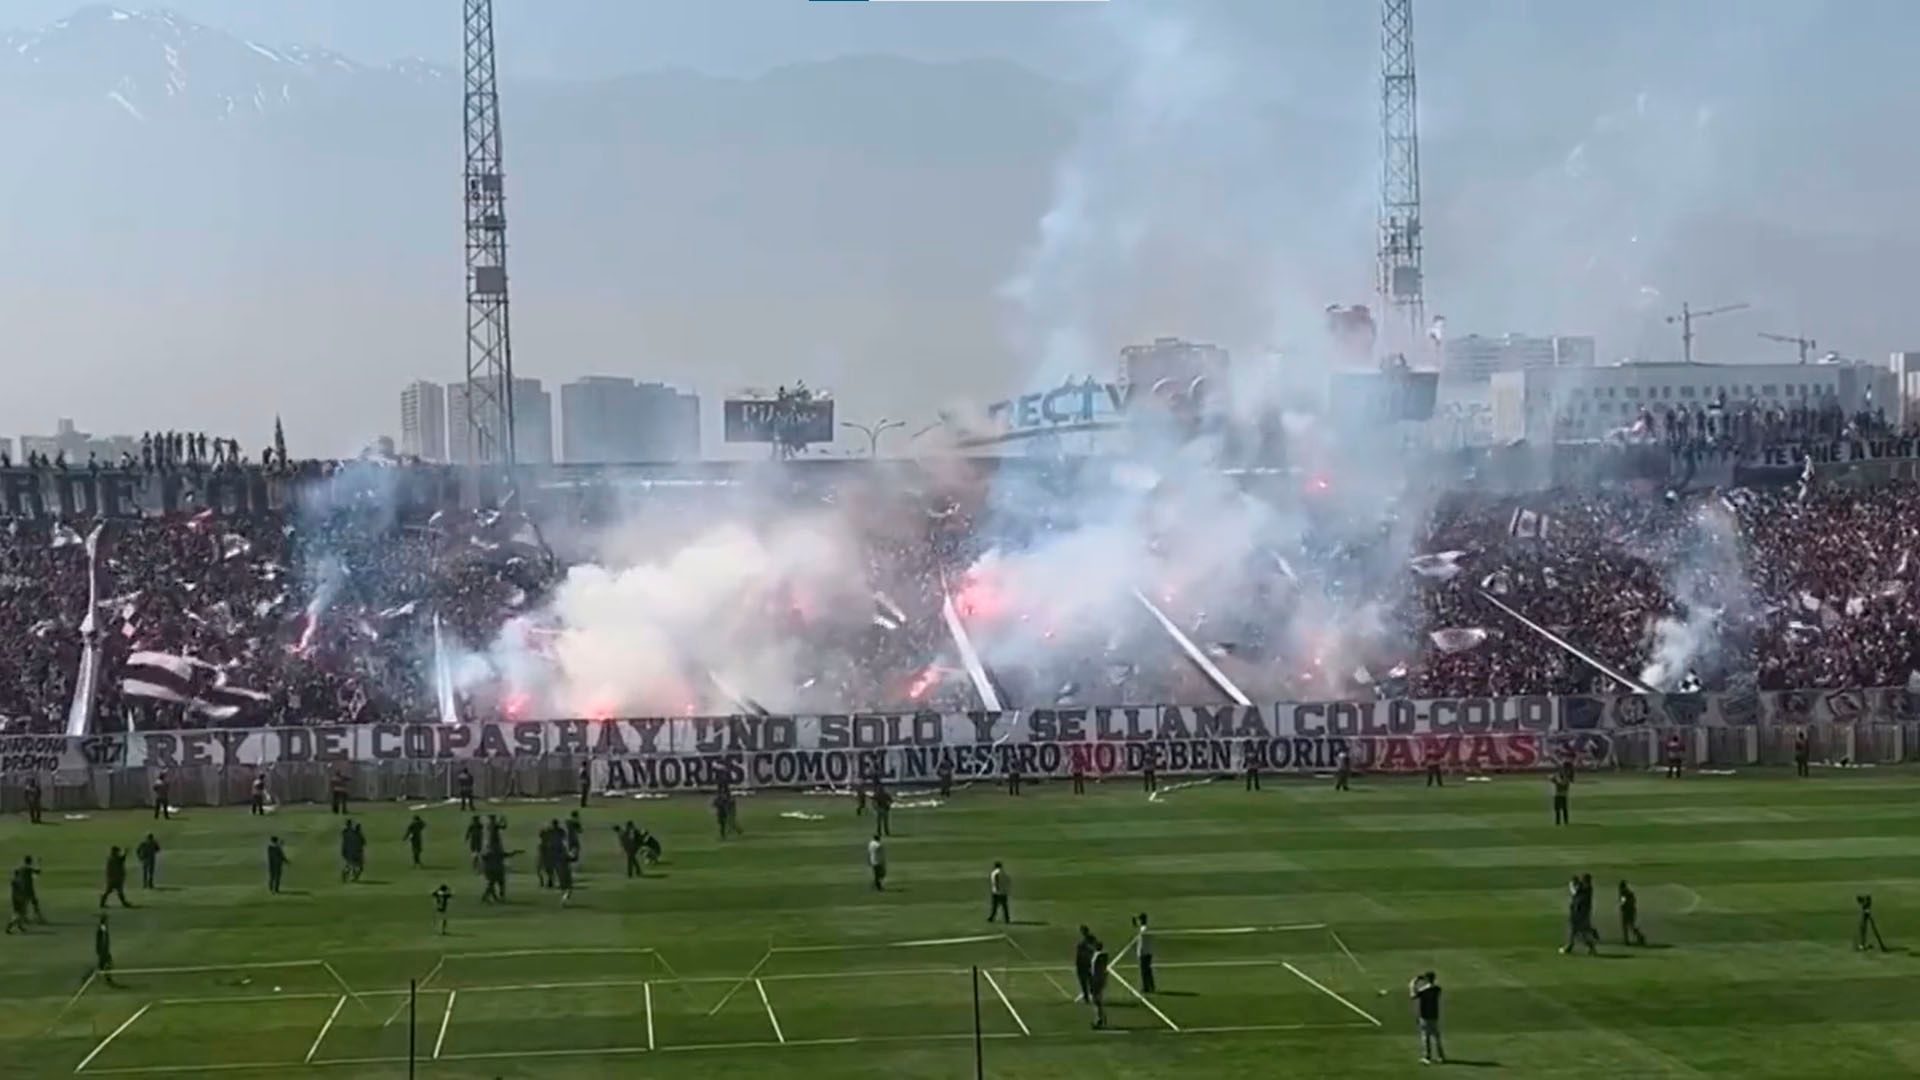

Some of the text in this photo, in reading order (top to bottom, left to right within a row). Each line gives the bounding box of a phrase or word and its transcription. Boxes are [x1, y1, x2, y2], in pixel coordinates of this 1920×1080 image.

[144, 731, 249, 771] REY
[278, 727, 349, 761] DE
[371, 722, 542, 759] COPAS
[555, 719, 665, 754] HAY
[696, 715, 797, 751] UNO
[819, 711, 943, 748] SOLO
[967, 711, 1002, 742] Y
[1028, 709, 1087, 742] SE
[1095, 704, 1270, 740] LLAMA
[1294, 698, 1551, 737] COLO-COLO
[607, 755, 744, 790] AMORES
[754, 751, 848, 784] COMO
[857, 749, 896, 781] EL
[904, 743, 1061, 778] NUESTRO
[1070, 743, 1116, 773] NO
[1127, 739, 1232, 771] DEBEN
